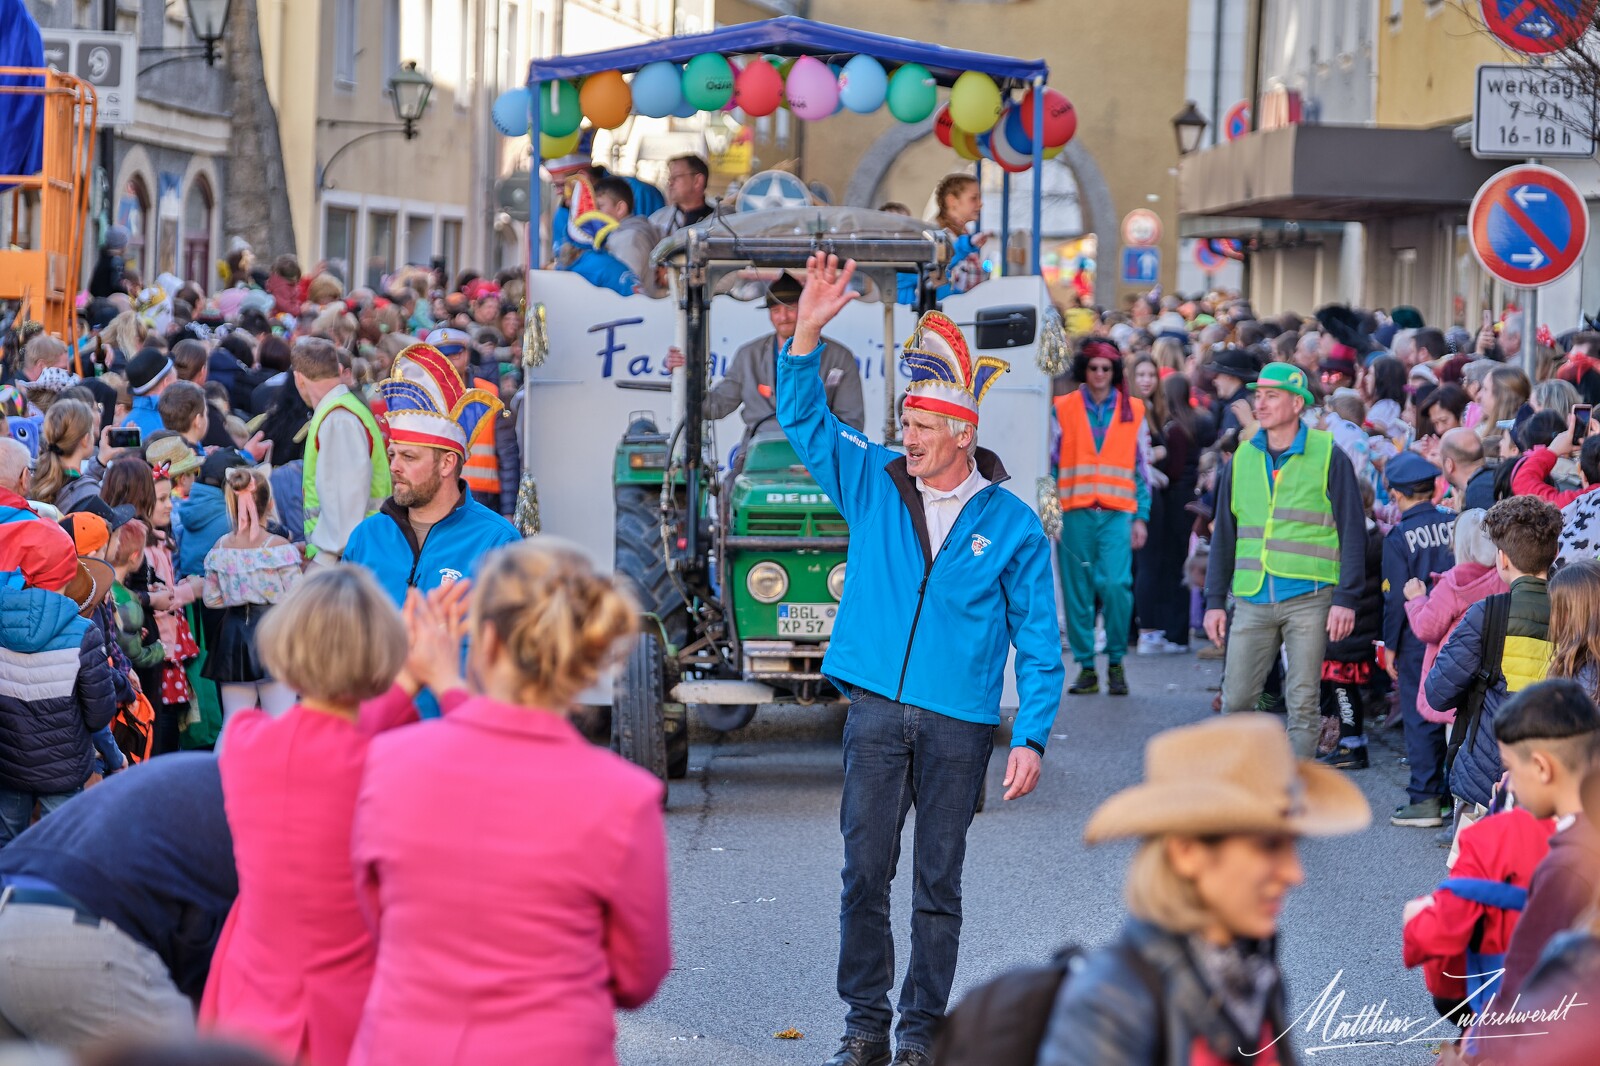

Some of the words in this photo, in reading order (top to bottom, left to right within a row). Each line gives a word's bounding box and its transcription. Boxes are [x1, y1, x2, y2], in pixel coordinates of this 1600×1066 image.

[1554, 102, 1563, 120] h
[1500, 126, 1555, 145] 16-18
[1562, 127, 1571, 145] h
[790, 606, 819, 619] BGL
[782, 620, 801, 633] XP
[806, 620, 824, 633] 57
